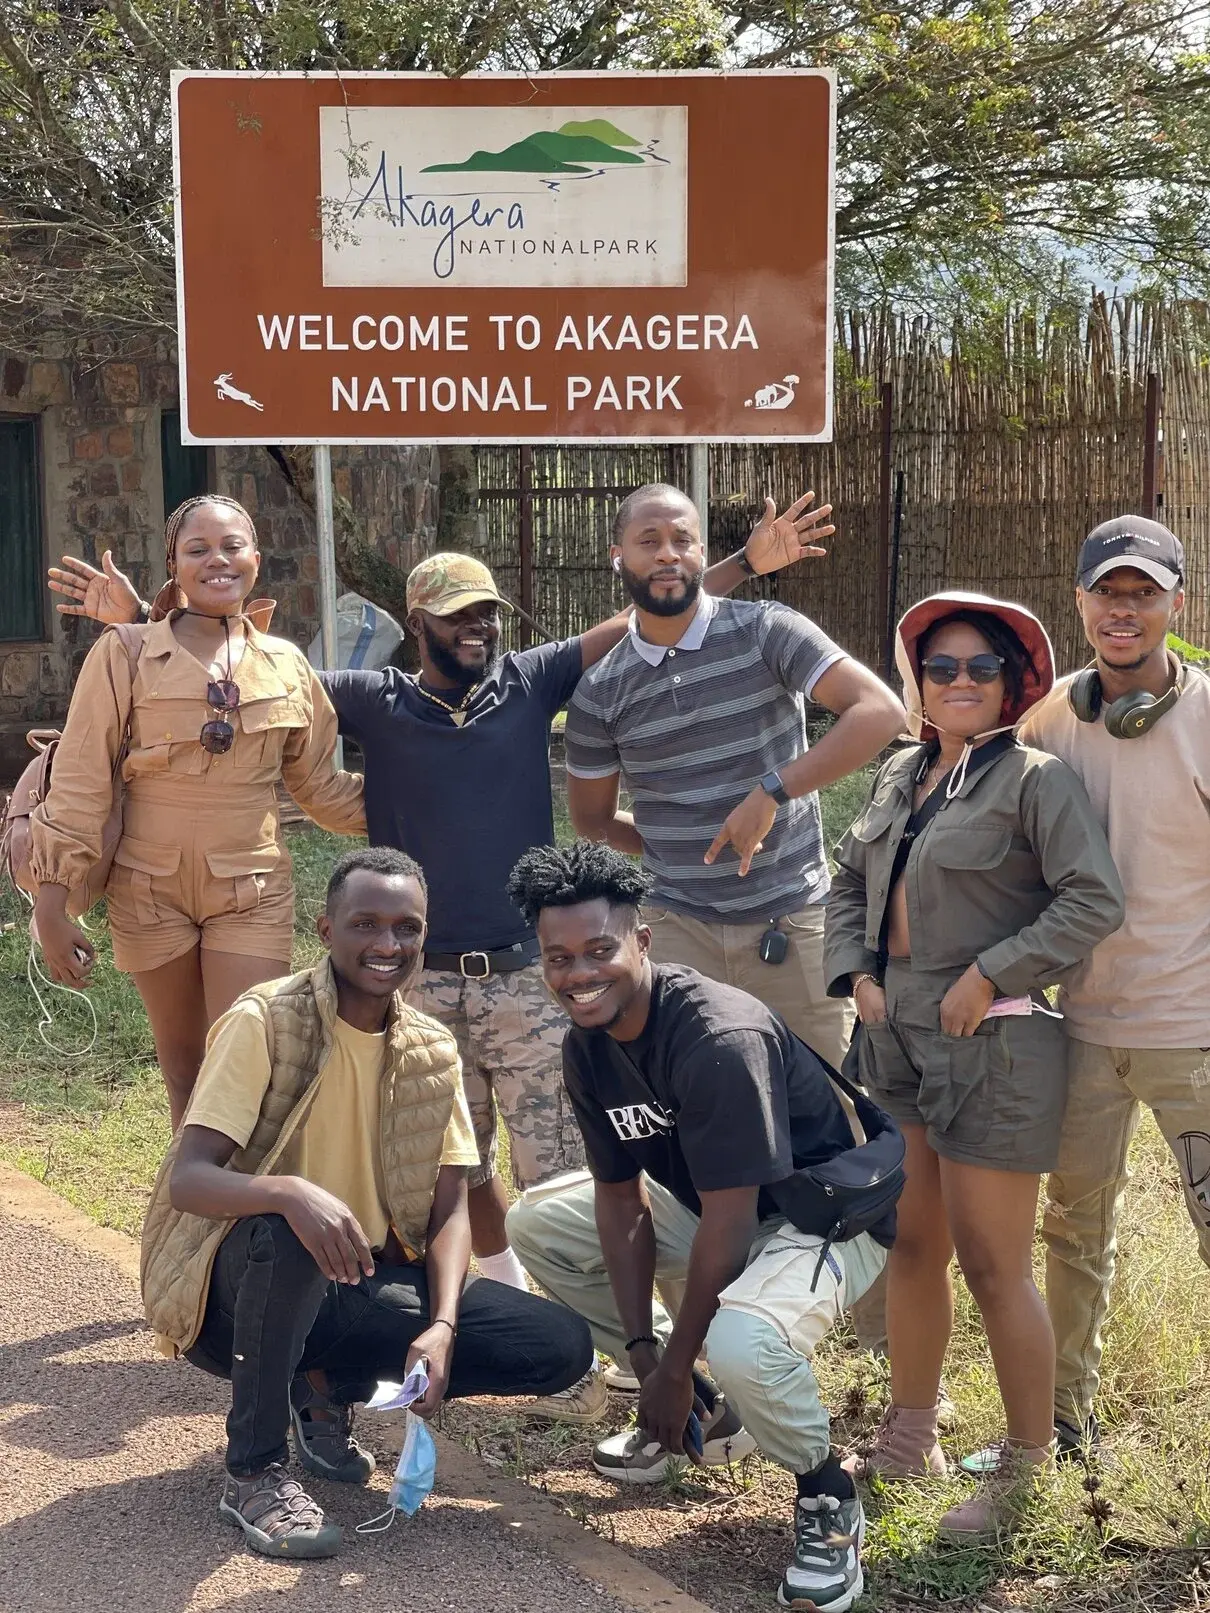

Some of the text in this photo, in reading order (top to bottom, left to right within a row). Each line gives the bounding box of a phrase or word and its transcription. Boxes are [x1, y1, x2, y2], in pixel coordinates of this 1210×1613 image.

[351, 150, 525, 279] Akagera
[257, 314, 759, 351] WELCOME TO AKAGERA
[332, 375, 683, 412] NATIONAL PARK
